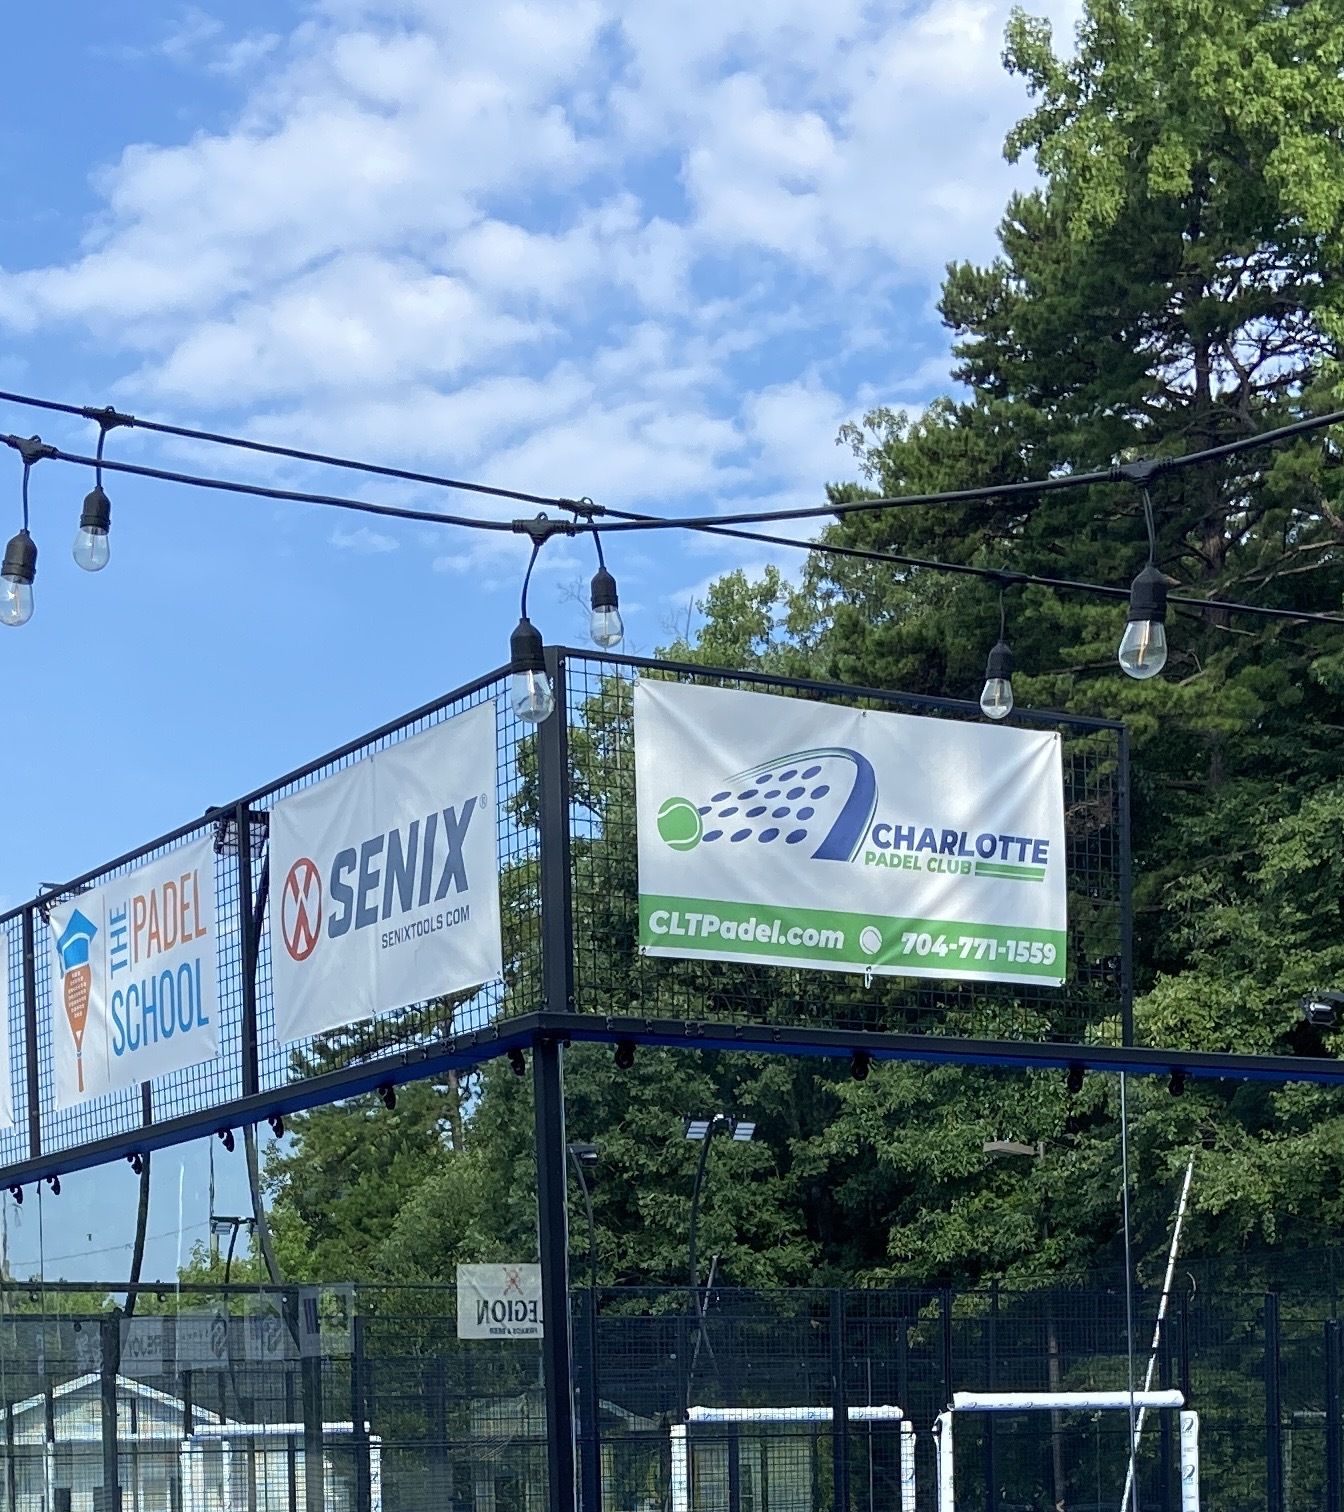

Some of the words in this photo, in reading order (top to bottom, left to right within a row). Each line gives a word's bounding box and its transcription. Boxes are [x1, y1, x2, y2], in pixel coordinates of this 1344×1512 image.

[864, 850, 922, 871] PADEL
[927, 857, 973, 876] CLUB
[871, 823, 1050, 865] CHARLOTTE
[109, 901, 128, 980] THE
[133, 868, 208, 964] PADEL
[648, 910, 846, 950] CLTPadel.com
[901, 932, 1057, 966] 704-771-1559
[111, 957, 209, 1057] SCHOOL
